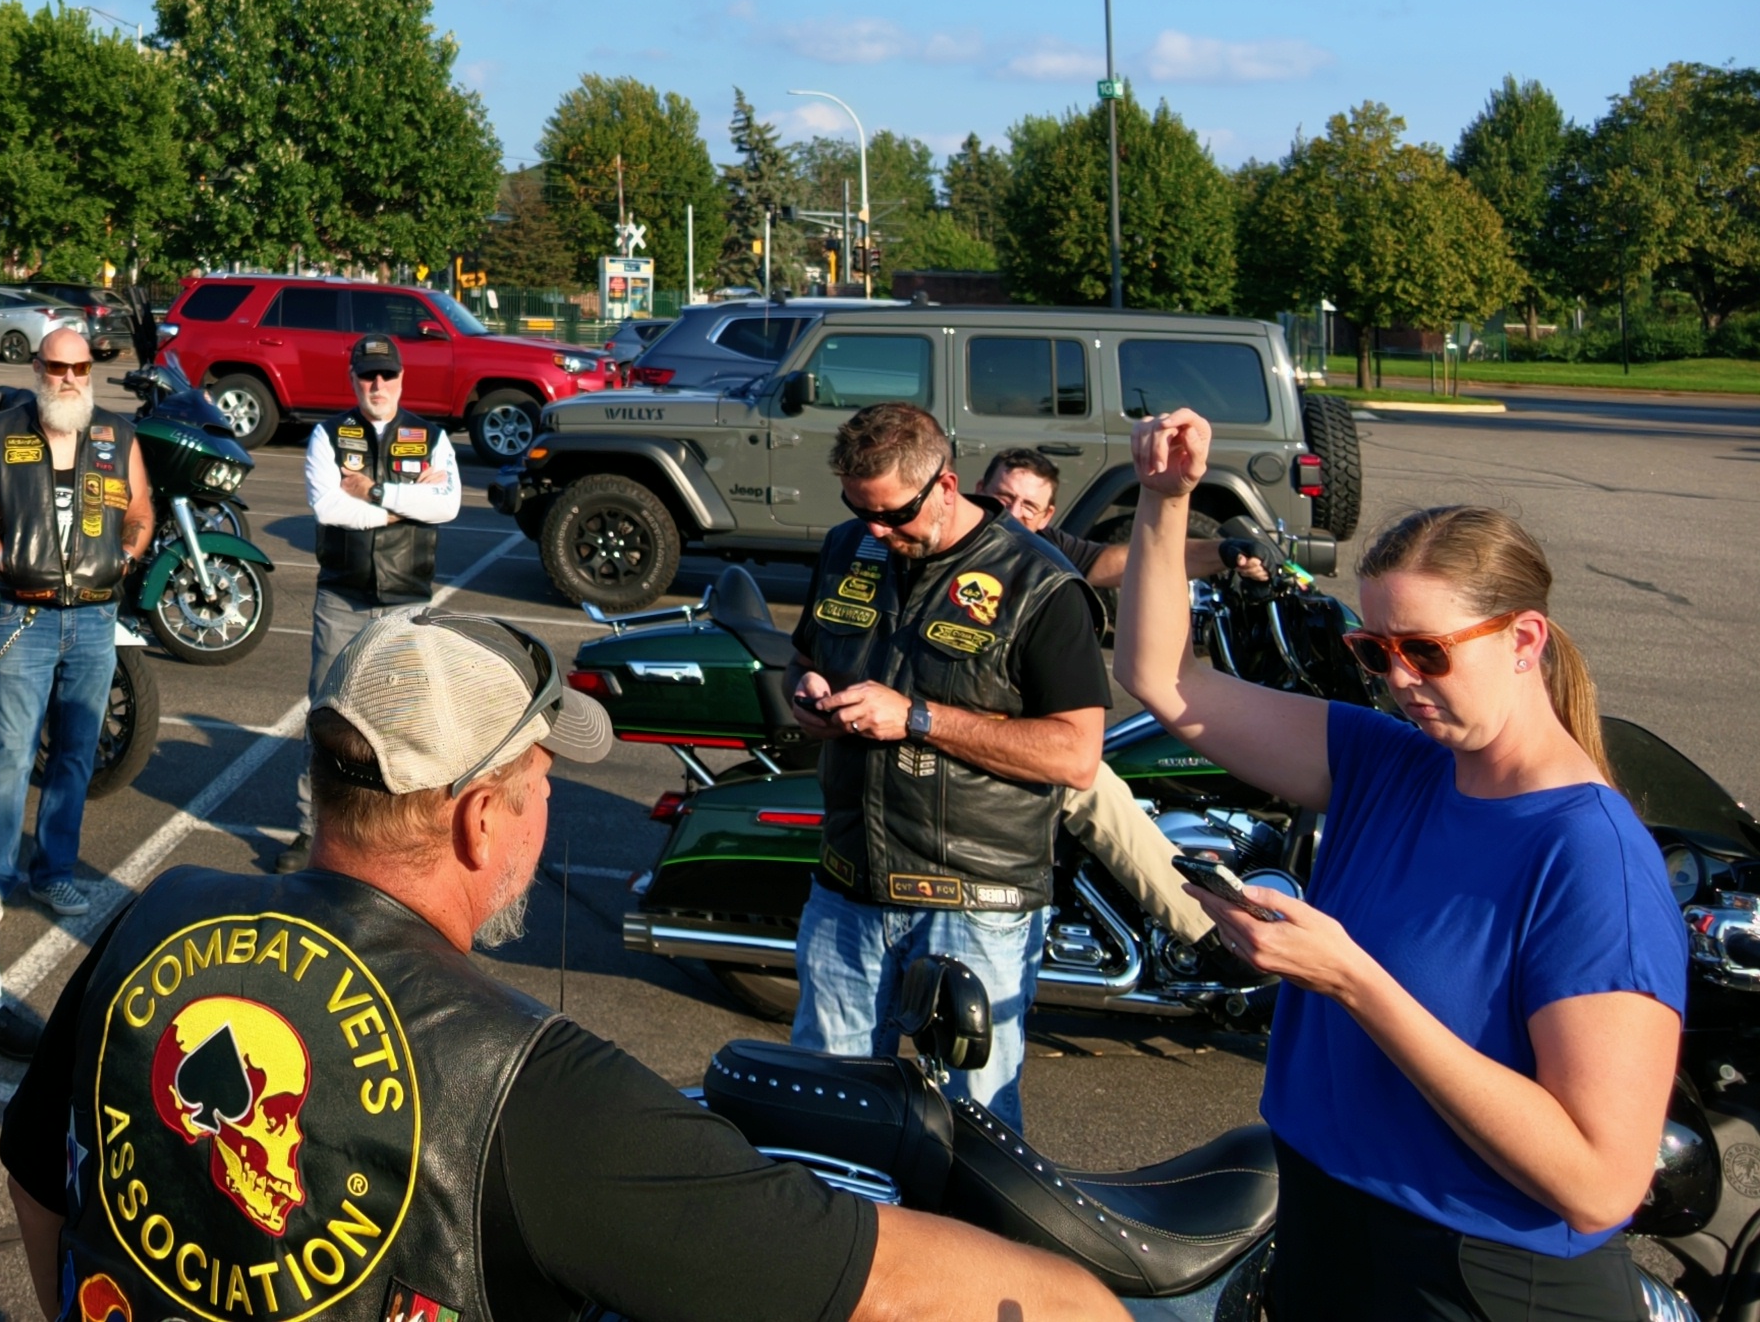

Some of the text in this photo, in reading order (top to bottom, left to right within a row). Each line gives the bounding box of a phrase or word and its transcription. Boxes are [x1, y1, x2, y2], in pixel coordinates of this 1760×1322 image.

[604, 407, 666, 421] WILLYS
[729, 483, 764, 497] Jeep
[979, 888, 1006, 904] SEND
[124, 927, 404, 1115] COMBAT VETS
[104, 1104, 382, 1316] ASSOCIATION
